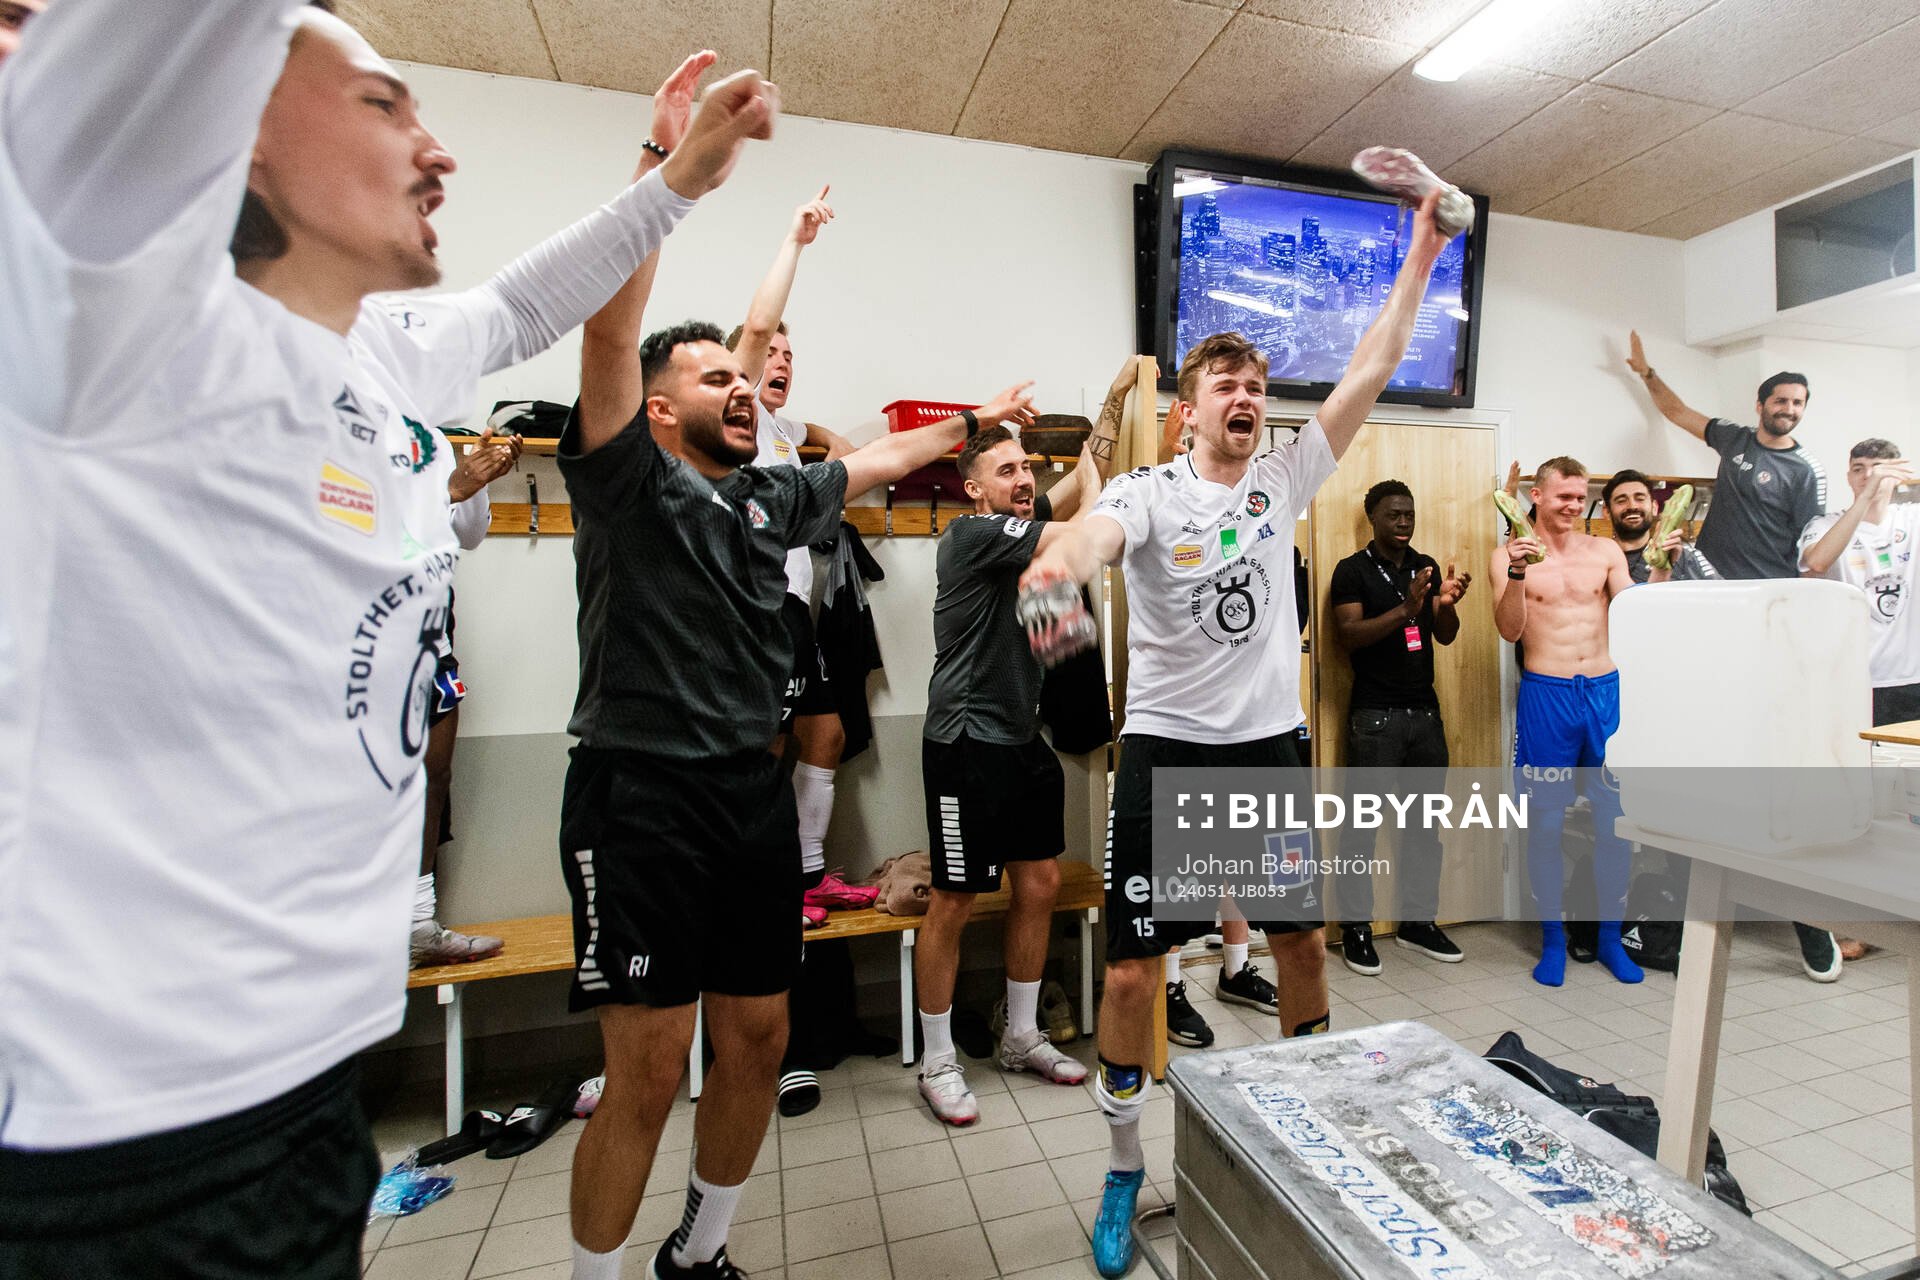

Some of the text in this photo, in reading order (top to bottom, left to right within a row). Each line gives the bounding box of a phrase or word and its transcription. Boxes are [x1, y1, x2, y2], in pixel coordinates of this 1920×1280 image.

[1256, 521, 1276, 543] NA
[1132, 917, 1155, 937] 15
[628, 955, 650, 978] RI
[1345, 1122, 1407, 1157] SK
